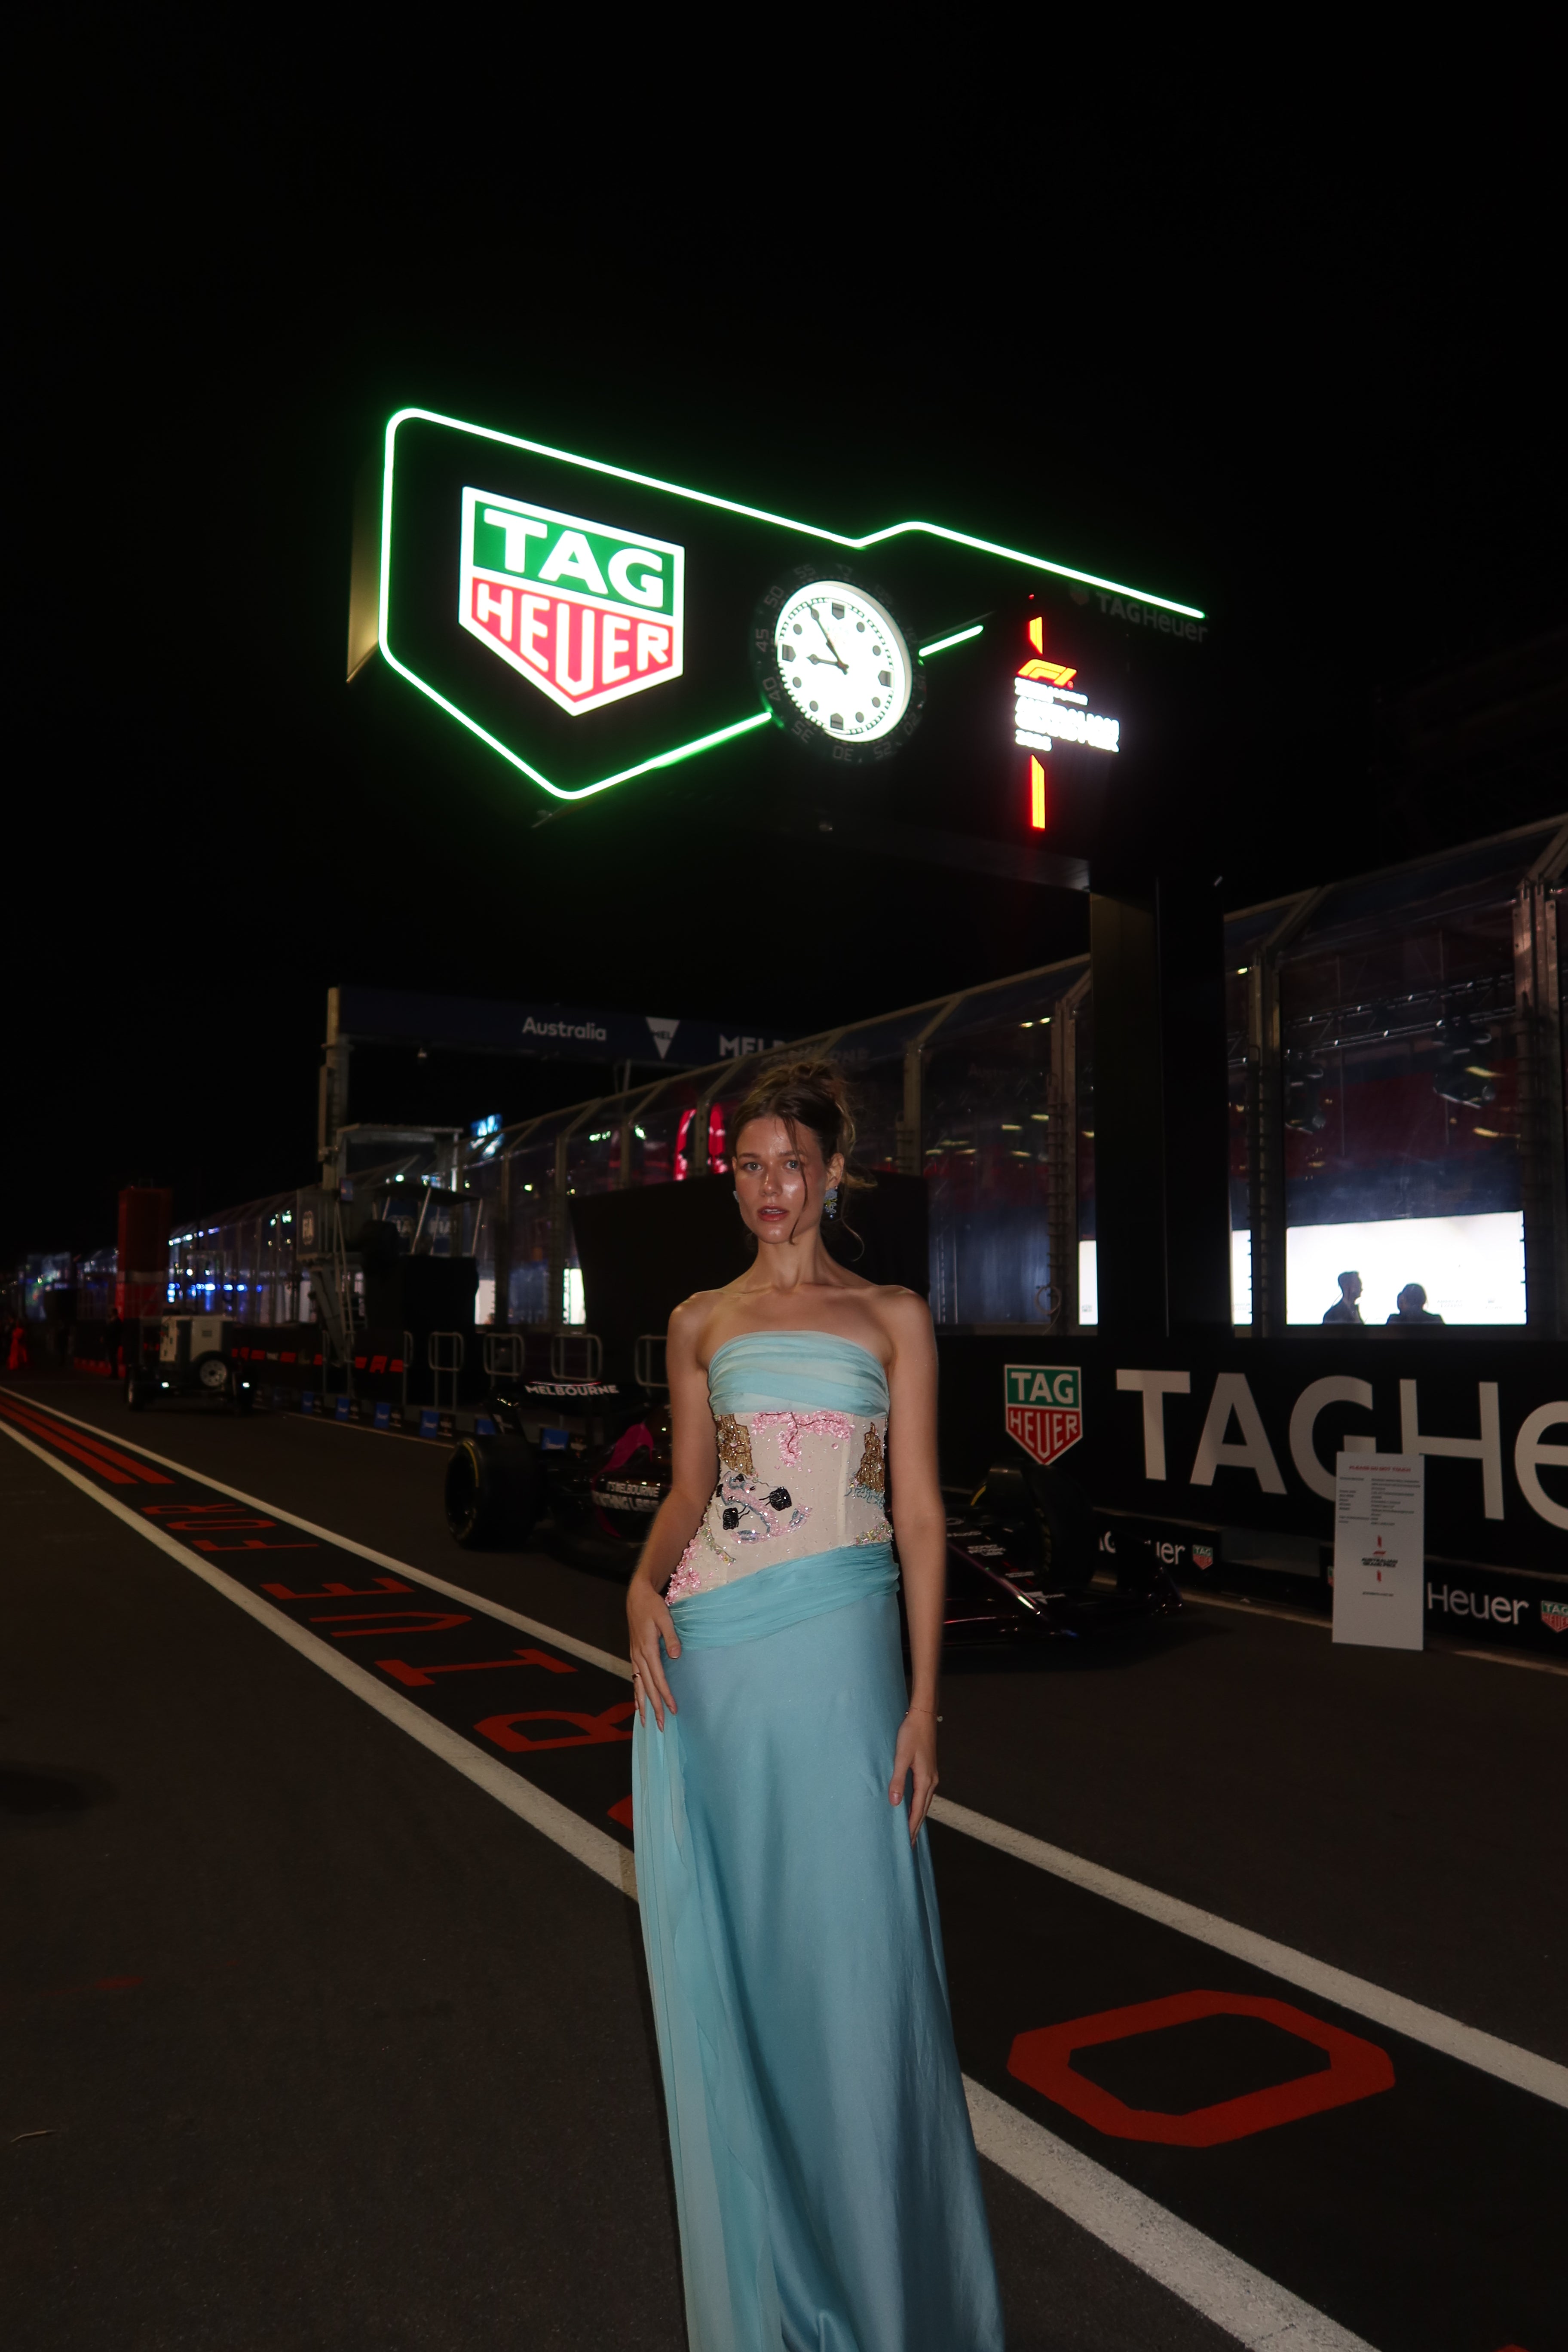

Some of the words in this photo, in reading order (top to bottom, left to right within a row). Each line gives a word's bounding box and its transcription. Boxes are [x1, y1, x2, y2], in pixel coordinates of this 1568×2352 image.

[484, 507, 664, 608] TAG
[793, 564, 817, 579] 55
[763, 585, 784, 606] 50
[476, 582, 670, 697] HEUER
[755, 628, 769, 653] 45
[763, 677, 781, 701] 40
[833, 746, 854, 762] 30
[522, 1015, 607, 1042] Australia
[524, 1384, 620, 1396] MELBOURNE
[1011, 1372, 1074, 1405] TAG
[1010, 1410, 1078, 1460] HEUER
[139, 1502, 319, 1552] FOR
[260, 1577, 634, 1831] RIVE
[1006, 1989, 1396, 2147] O
